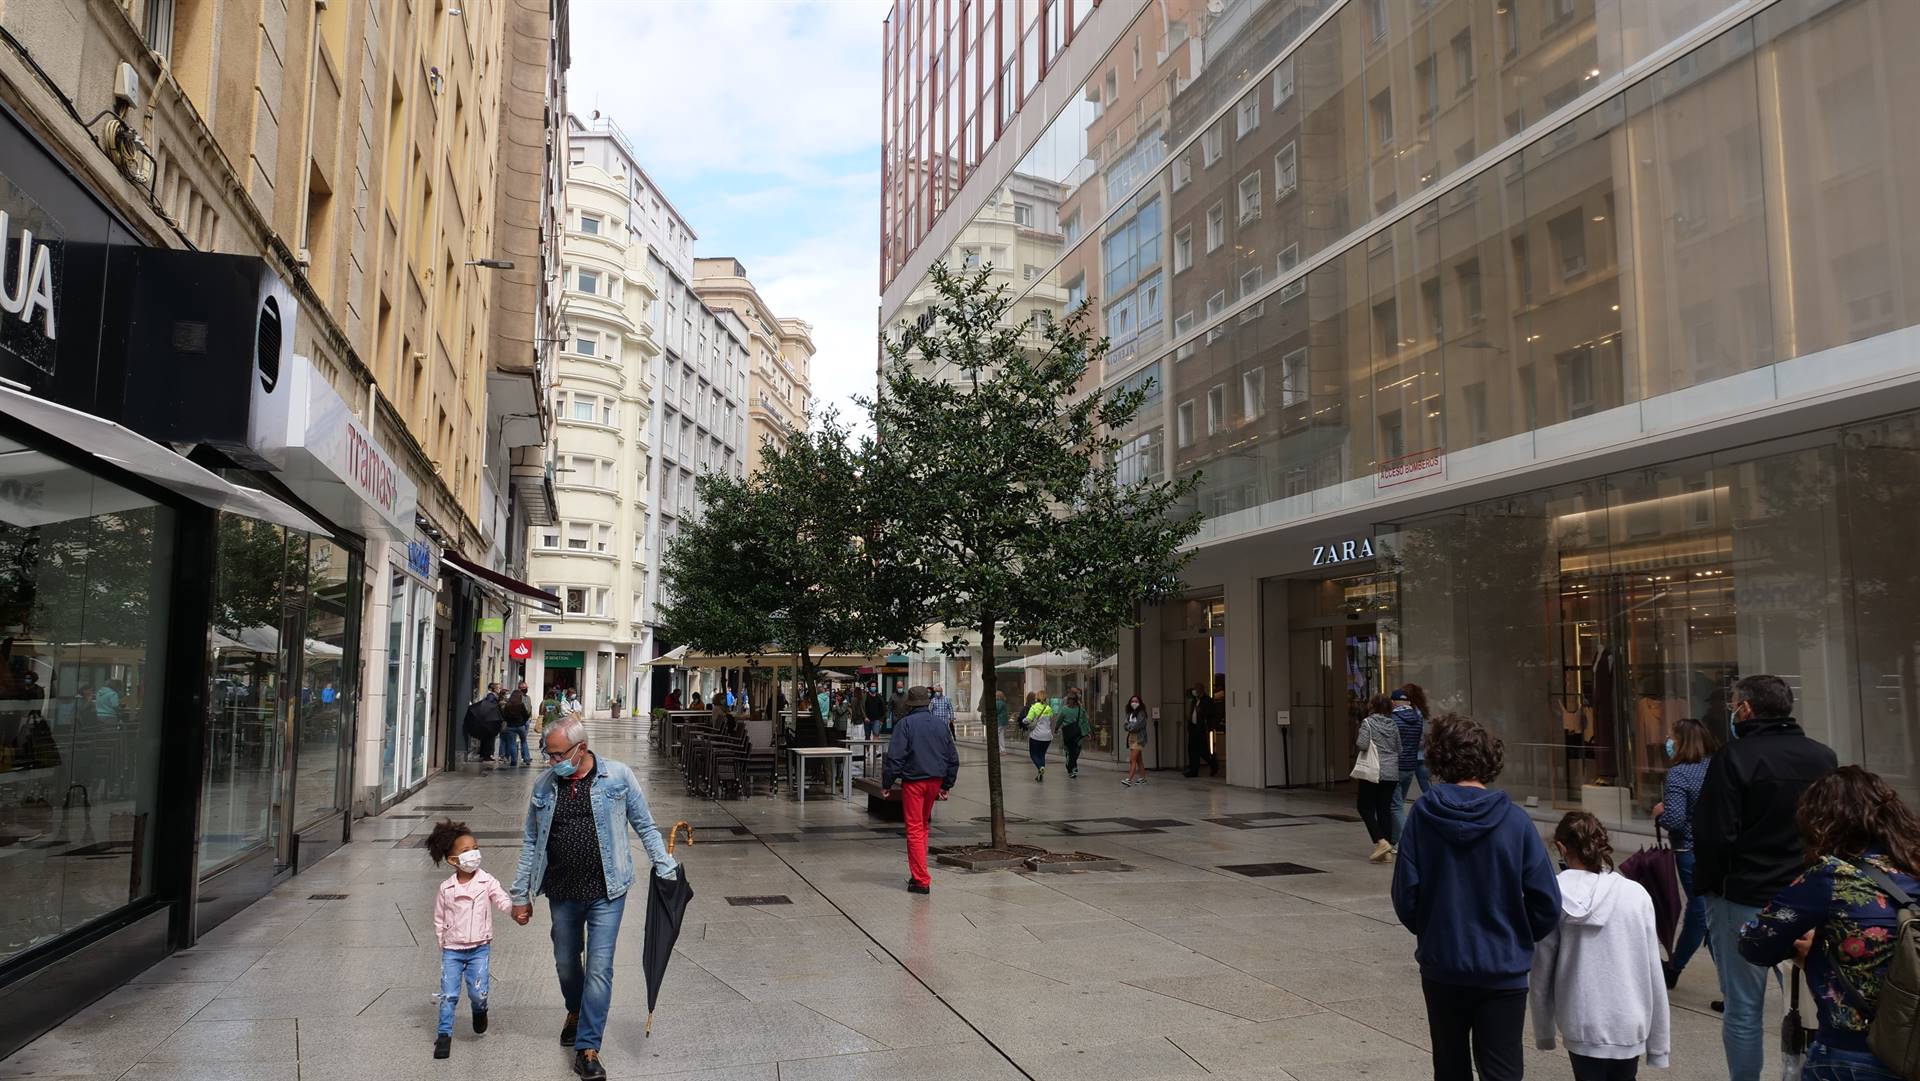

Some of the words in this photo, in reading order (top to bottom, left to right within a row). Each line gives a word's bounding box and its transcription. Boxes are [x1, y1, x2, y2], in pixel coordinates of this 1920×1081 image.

[1380, 463, 1404, 479] ACCESO
[1404, 456, 1439, 474] BOMBEROS
[1312, 537, 1375, 566] ZARA
